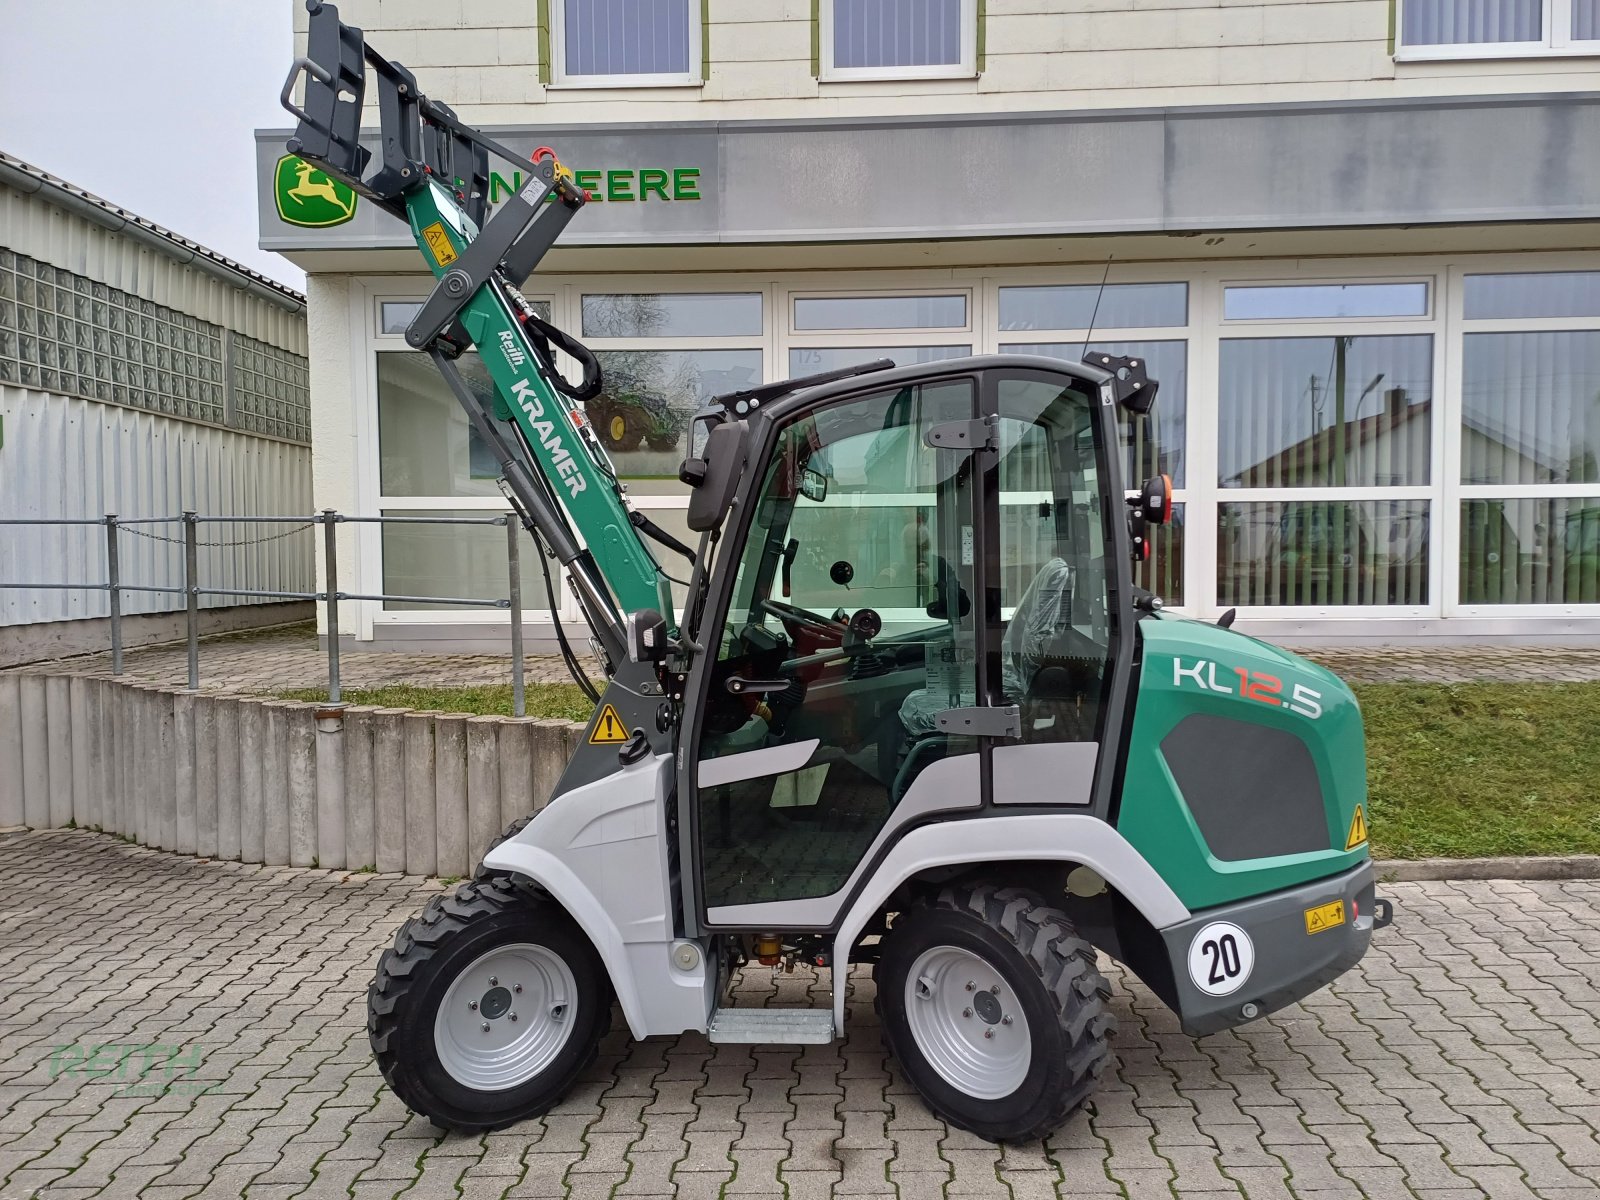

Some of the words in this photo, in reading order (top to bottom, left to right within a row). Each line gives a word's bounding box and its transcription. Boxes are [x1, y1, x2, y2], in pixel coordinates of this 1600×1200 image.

[545, 168, 701, 202] EERE
[498, 330, 525, 367] Reith
[511, 378, 587, 499] KRAMER
[1202, 934, 1241, 986] 20
